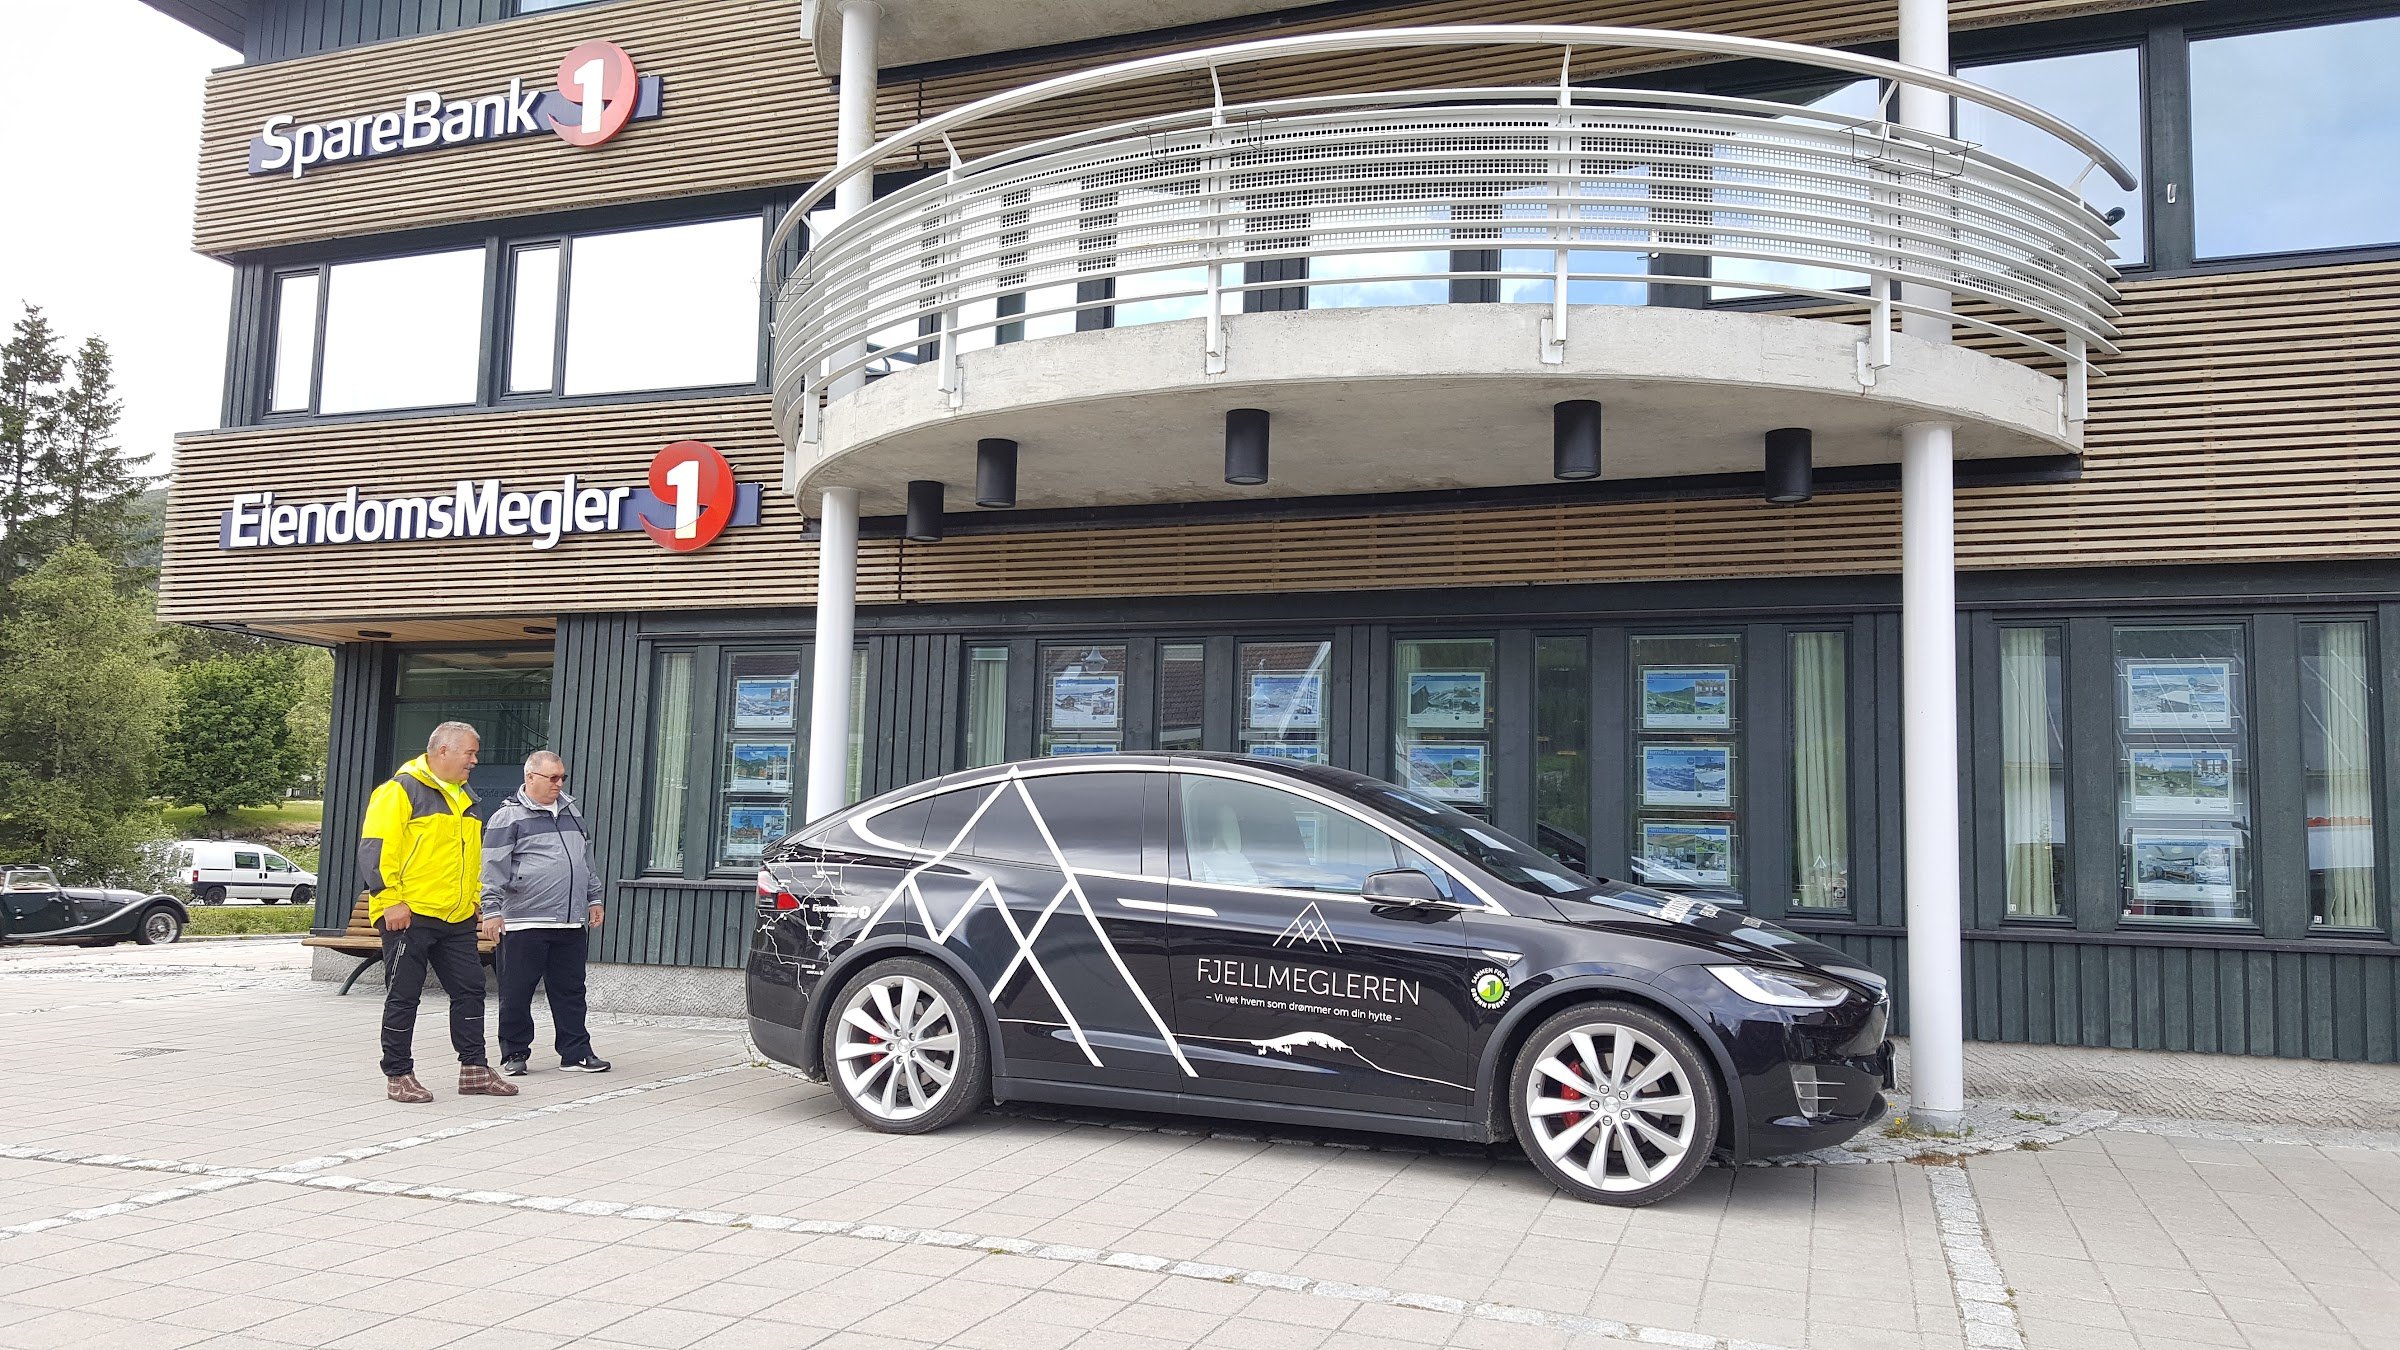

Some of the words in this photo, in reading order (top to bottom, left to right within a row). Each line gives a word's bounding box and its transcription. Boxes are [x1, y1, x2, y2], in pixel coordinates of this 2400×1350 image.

[260, 77, 540, 180] SpareBank
[573, 58, 604, 134] 1
[229, 474, 630, 550] EiendomsMegler
[666, 460, 700, 540] 1
[1198, 958, 1419, 1006] FJELLMEGLEREN
[1214, 992, 1223, 1003] Vi
[1225, 995, 1239, 1005] vet
[1240, 995, 1266, 1008] hvem
[1267, 1000, 1288, 1010] som
[1289, 1001, 1332, 1016] drømmer
[1333, 1007, 1350, 1017] om
[1351, 1009, 1366, 1019] din
[1368, 1010, 1393, 1023] hytte
